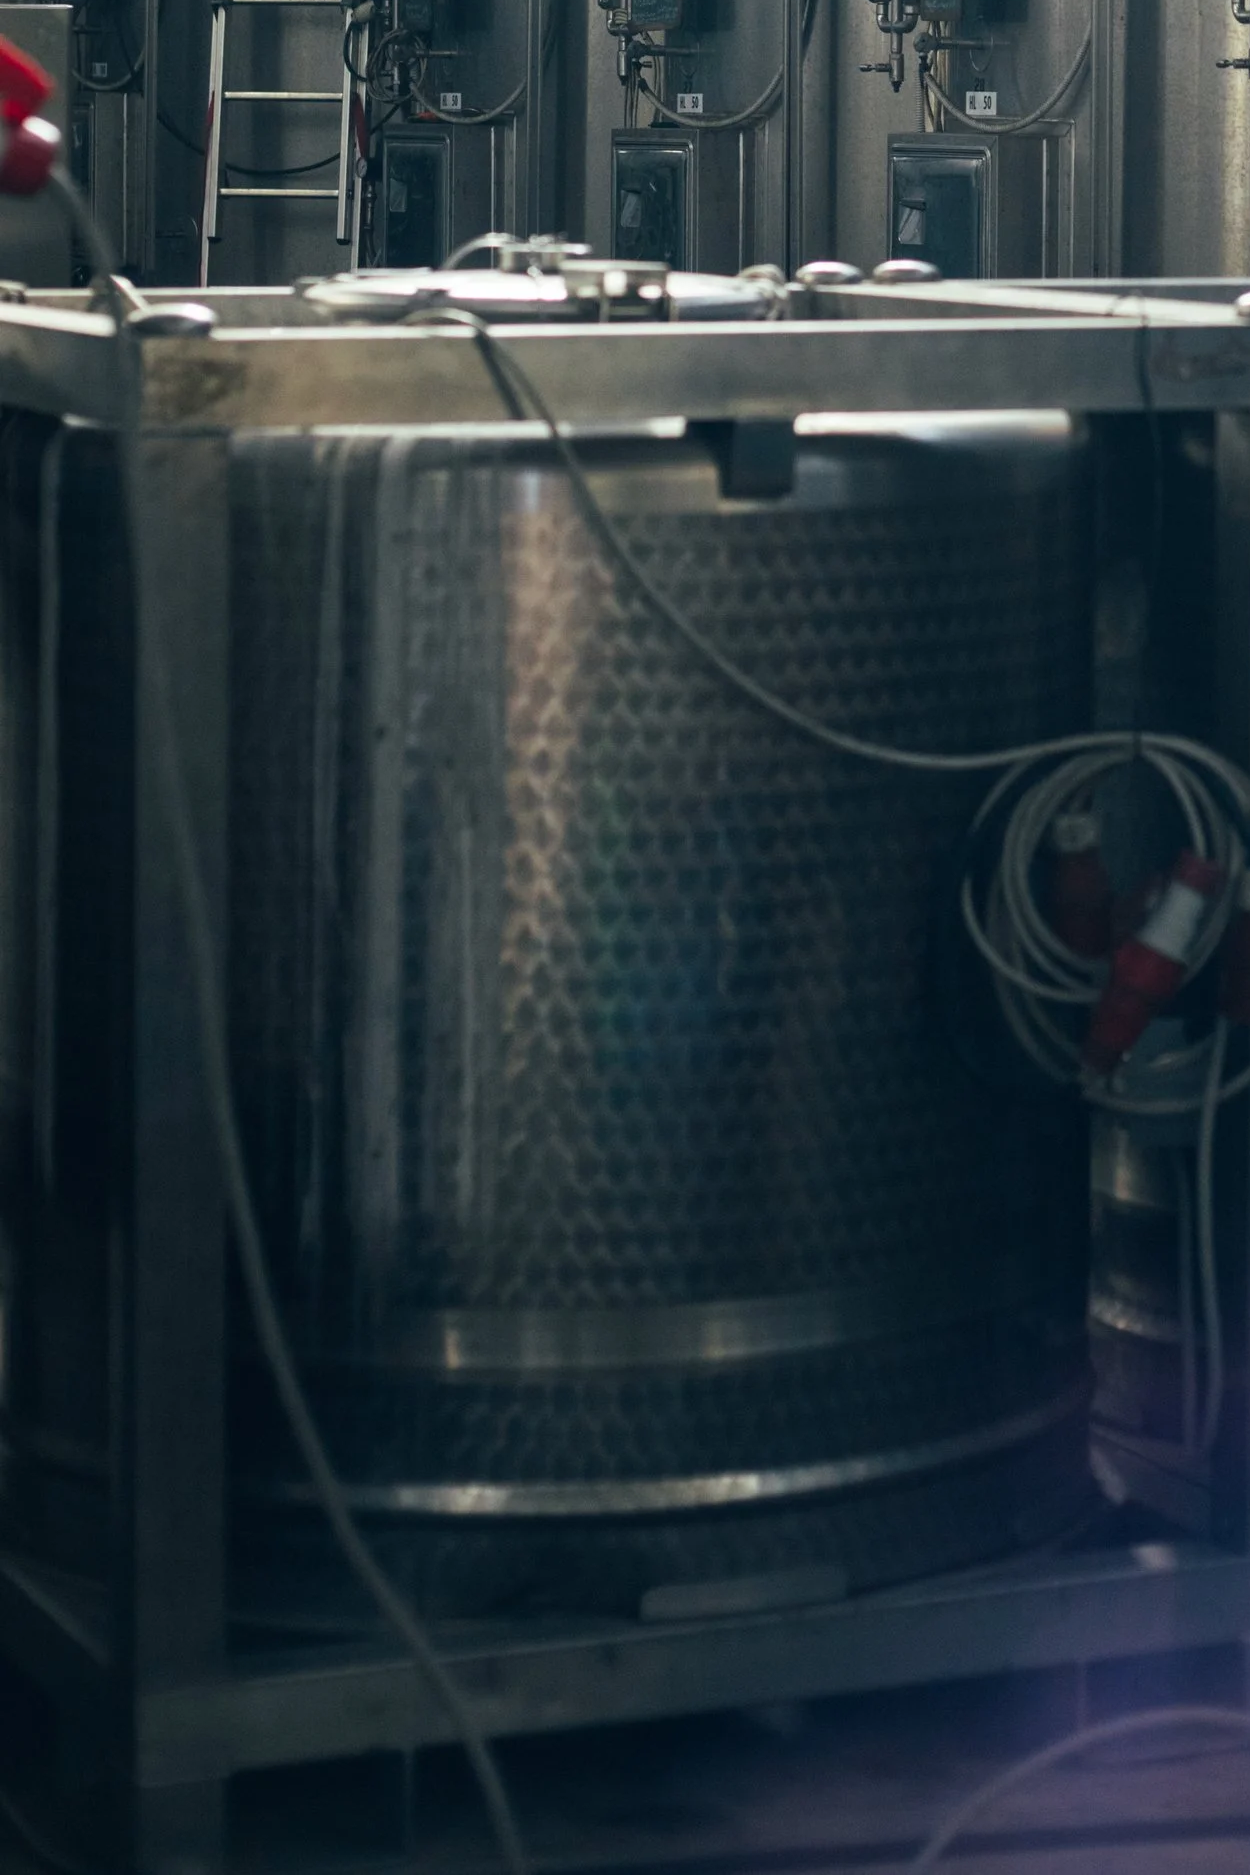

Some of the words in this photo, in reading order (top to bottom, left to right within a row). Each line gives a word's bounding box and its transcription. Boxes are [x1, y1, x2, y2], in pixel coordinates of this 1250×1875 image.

[452, 95, 458, 107] 50
[692, 96, 699, 109] 50
[969, 95, 977, 110] HL
[983, 95, 992, 110] 50
